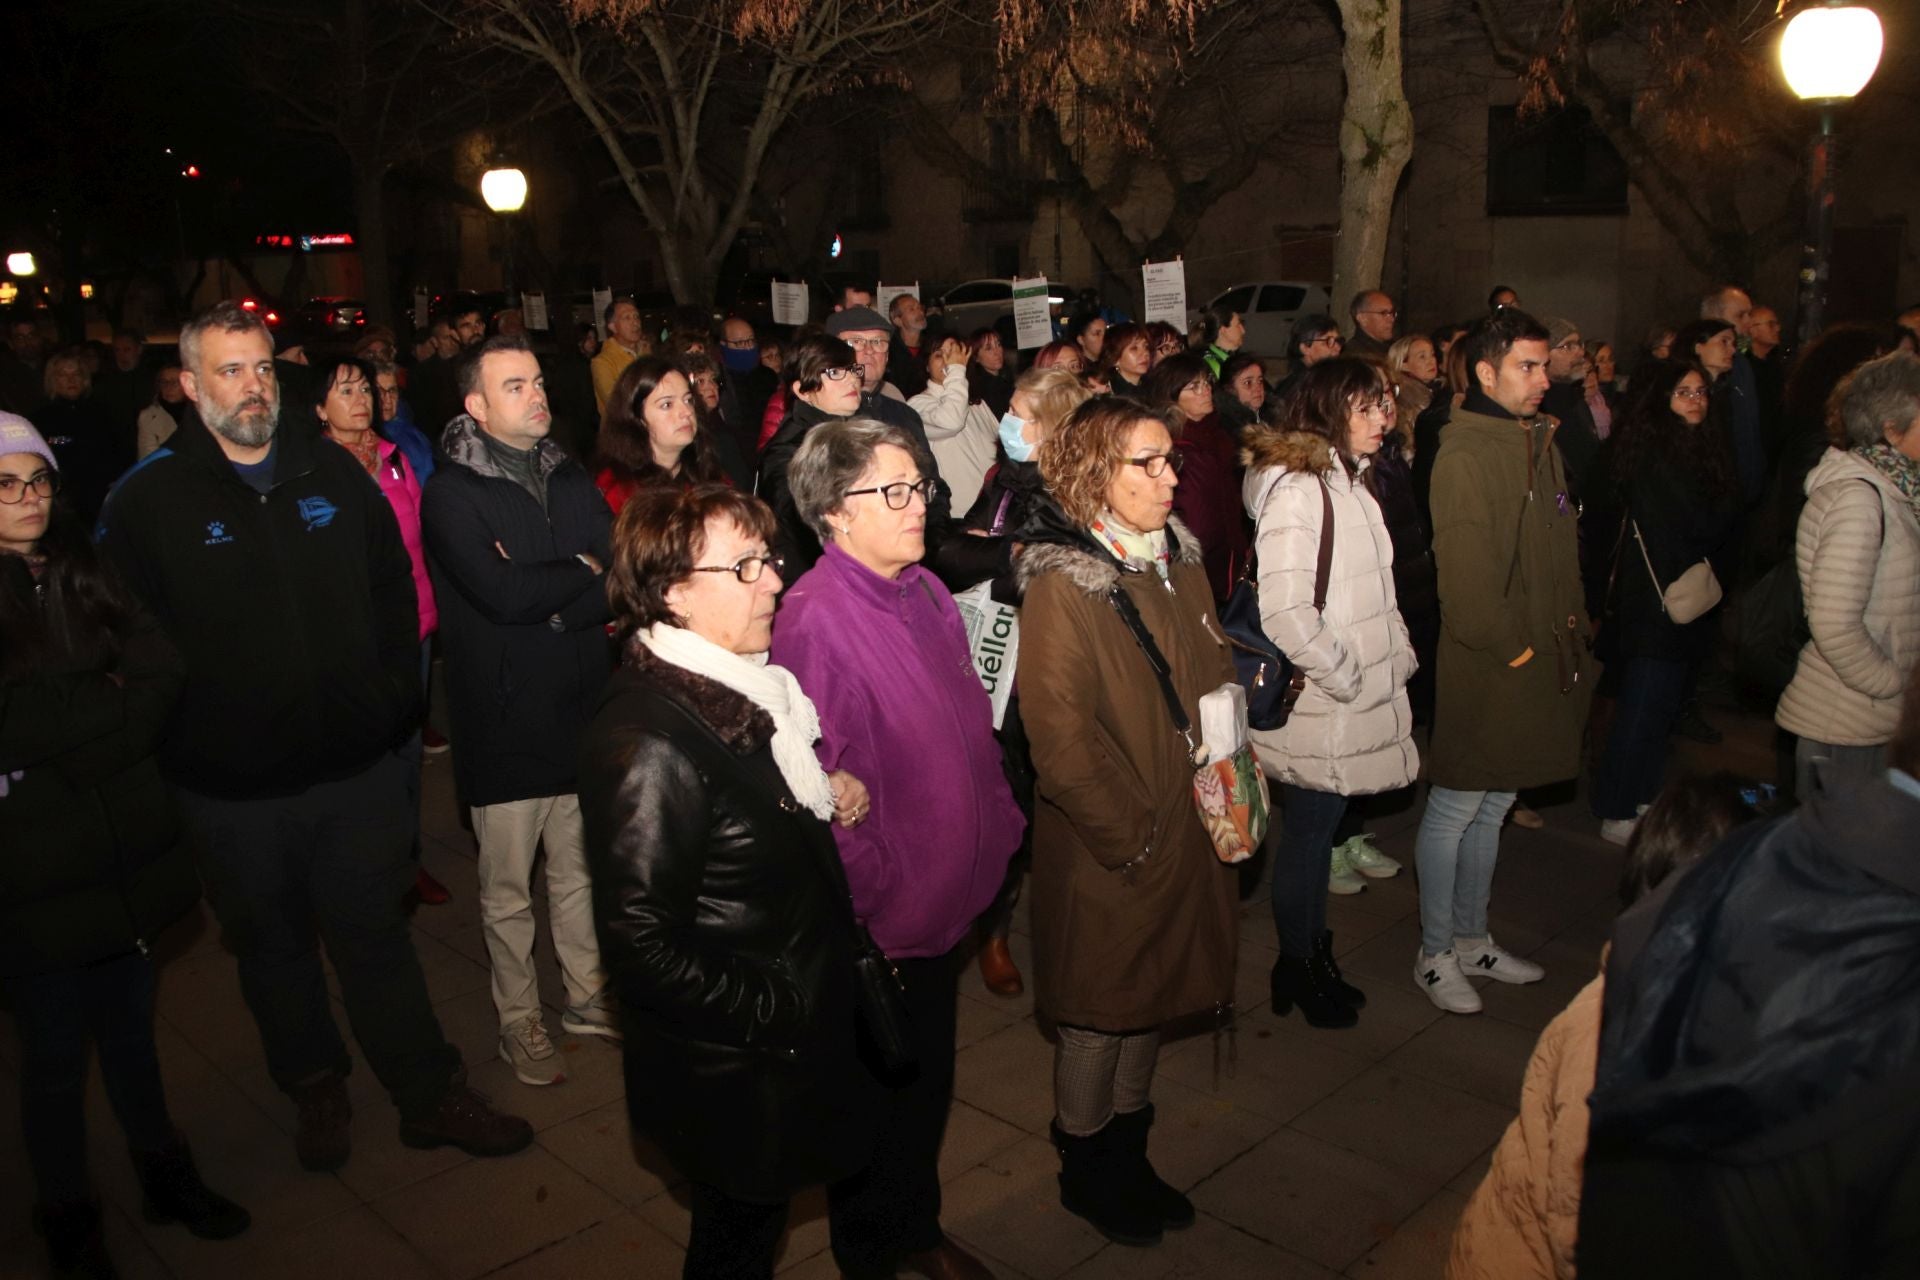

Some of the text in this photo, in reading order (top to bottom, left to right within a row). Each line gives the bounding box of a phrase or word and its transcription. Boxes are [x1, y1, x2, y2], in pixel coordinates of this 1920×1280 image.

[205, 536, 234, 545] KELME
[978, 607, 1014, 695] uéllar
[1476, 954, 1498, 970] N
[1424, 969, 1441, 986] N
